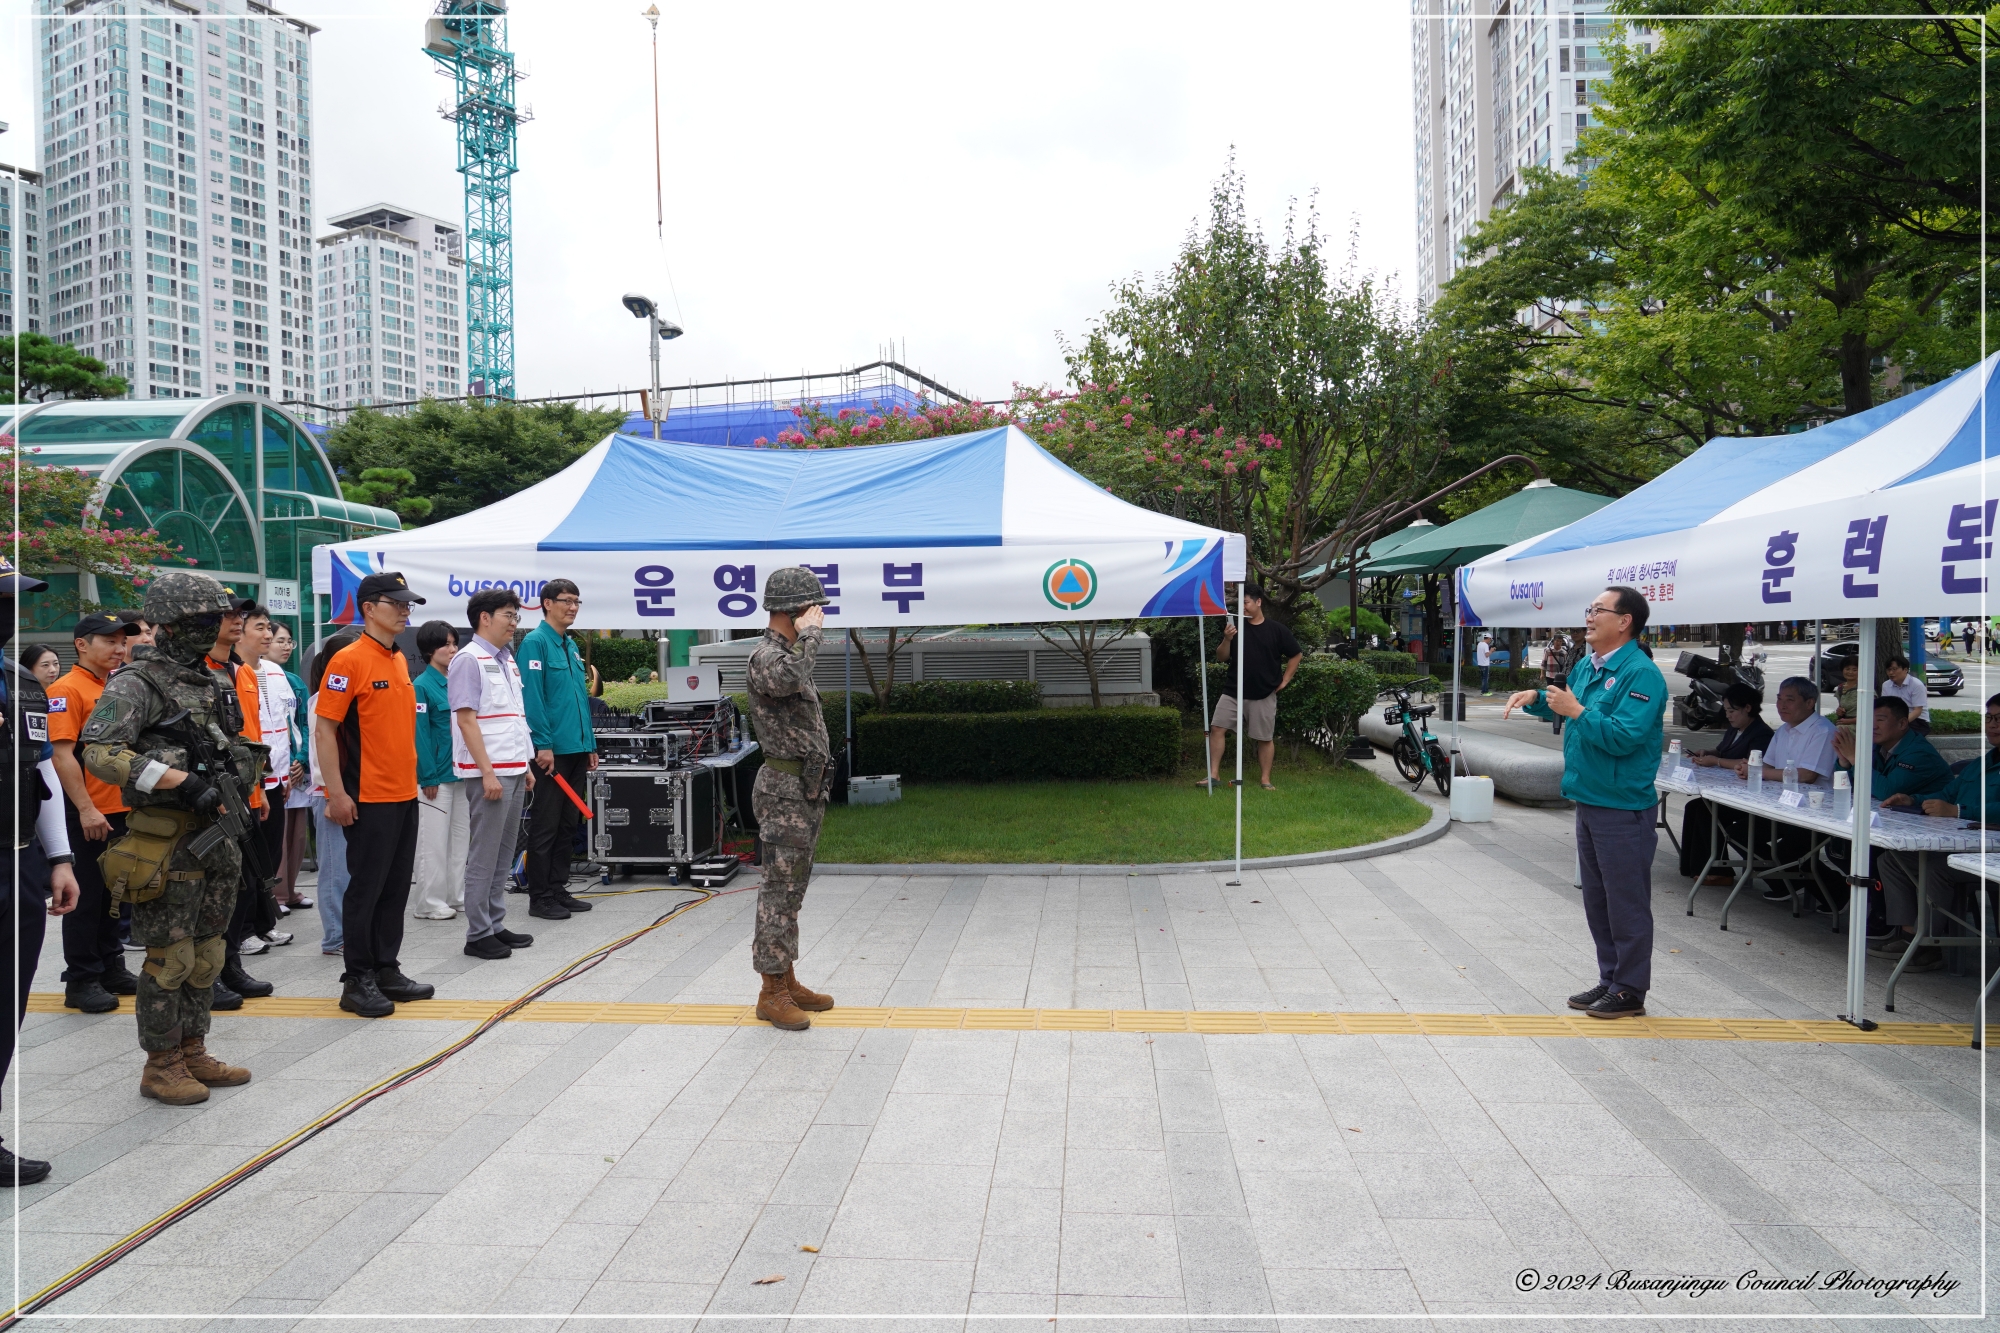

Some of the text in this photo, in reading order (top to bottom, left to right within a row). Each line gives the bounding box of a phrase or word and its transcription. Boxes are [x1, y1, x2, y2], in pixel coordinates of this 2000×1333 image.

[1607, 559, 1678, 583] 적 미사일 청사공격에
[1510, 580, 1544, 604] busanjin
[1658, 583, 1675, 602] 훈련
[31, 731, 46, 739] POLICE
